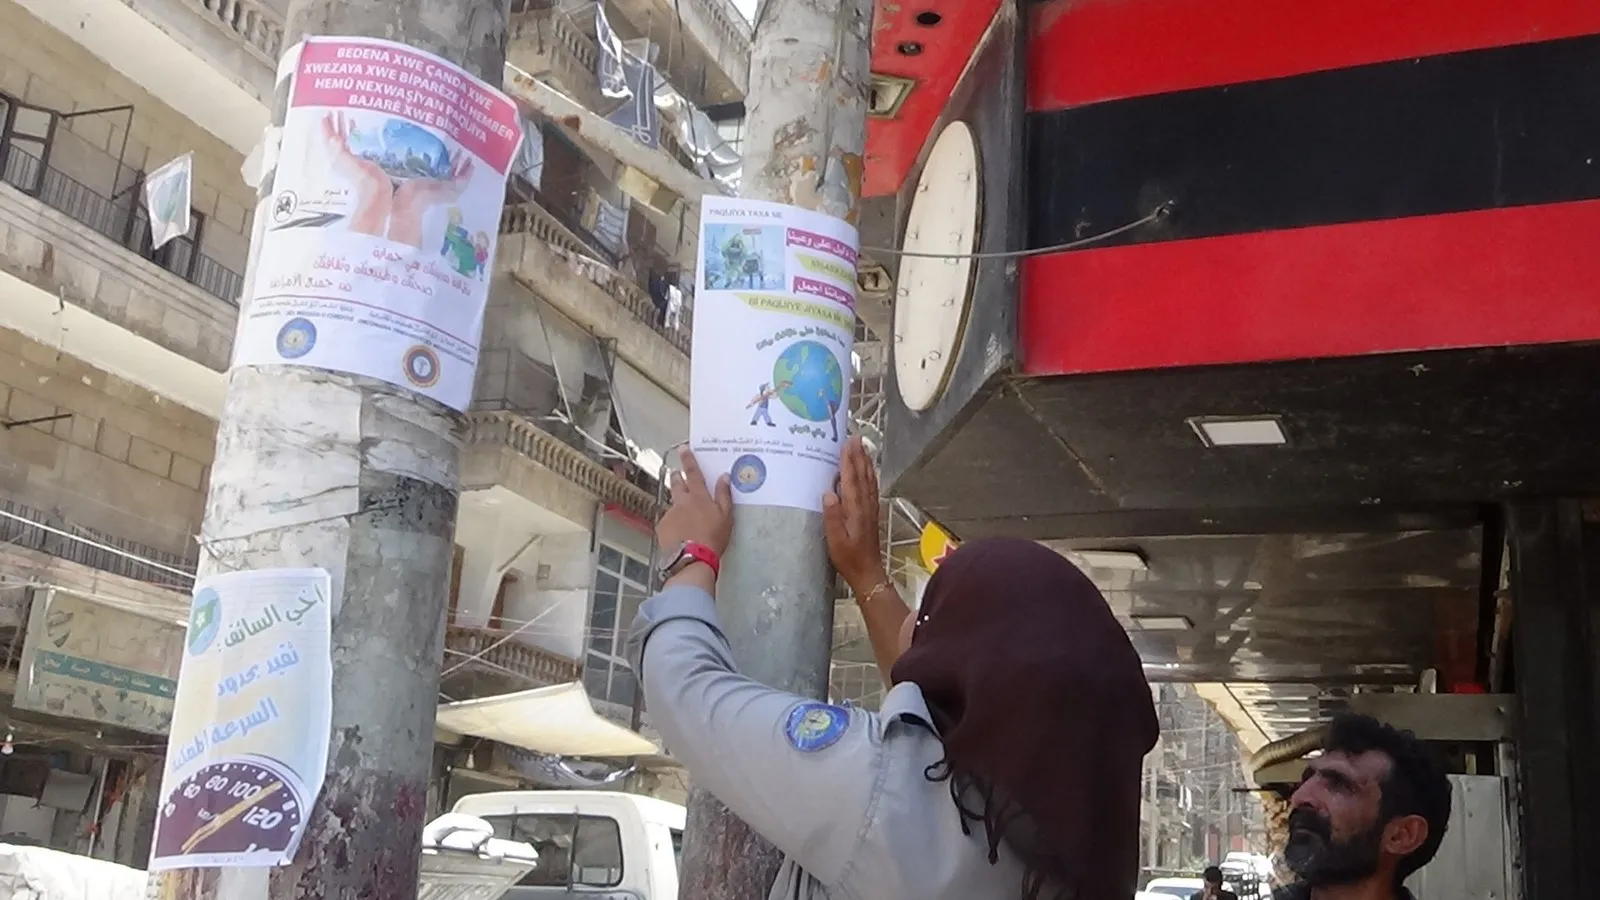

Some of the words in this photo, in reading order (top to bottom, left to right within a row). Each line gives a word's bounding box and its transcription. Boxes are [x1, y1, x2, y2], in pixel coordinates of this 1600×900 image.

[314, 76, 353, 90] HEMÛ
[336, 47, 390, 63] BEDENA
[392, 53, 424, 72] XWE
[425, 64, 467, 93] ÇANDA
[467, 87, 494, 111] XWE
[303, 63, 363, 75] XWEZAYA
[364, 64, 398, 80] XWE
[468, 106, 514, 141] HEMBER
[402, 104, 434, 125] XWE
[813, 238, 831, 249] على
[205, 774, 229, 792] 80
[227, 780, 262, 800] 100
[242, 805, 284, 830] 120
